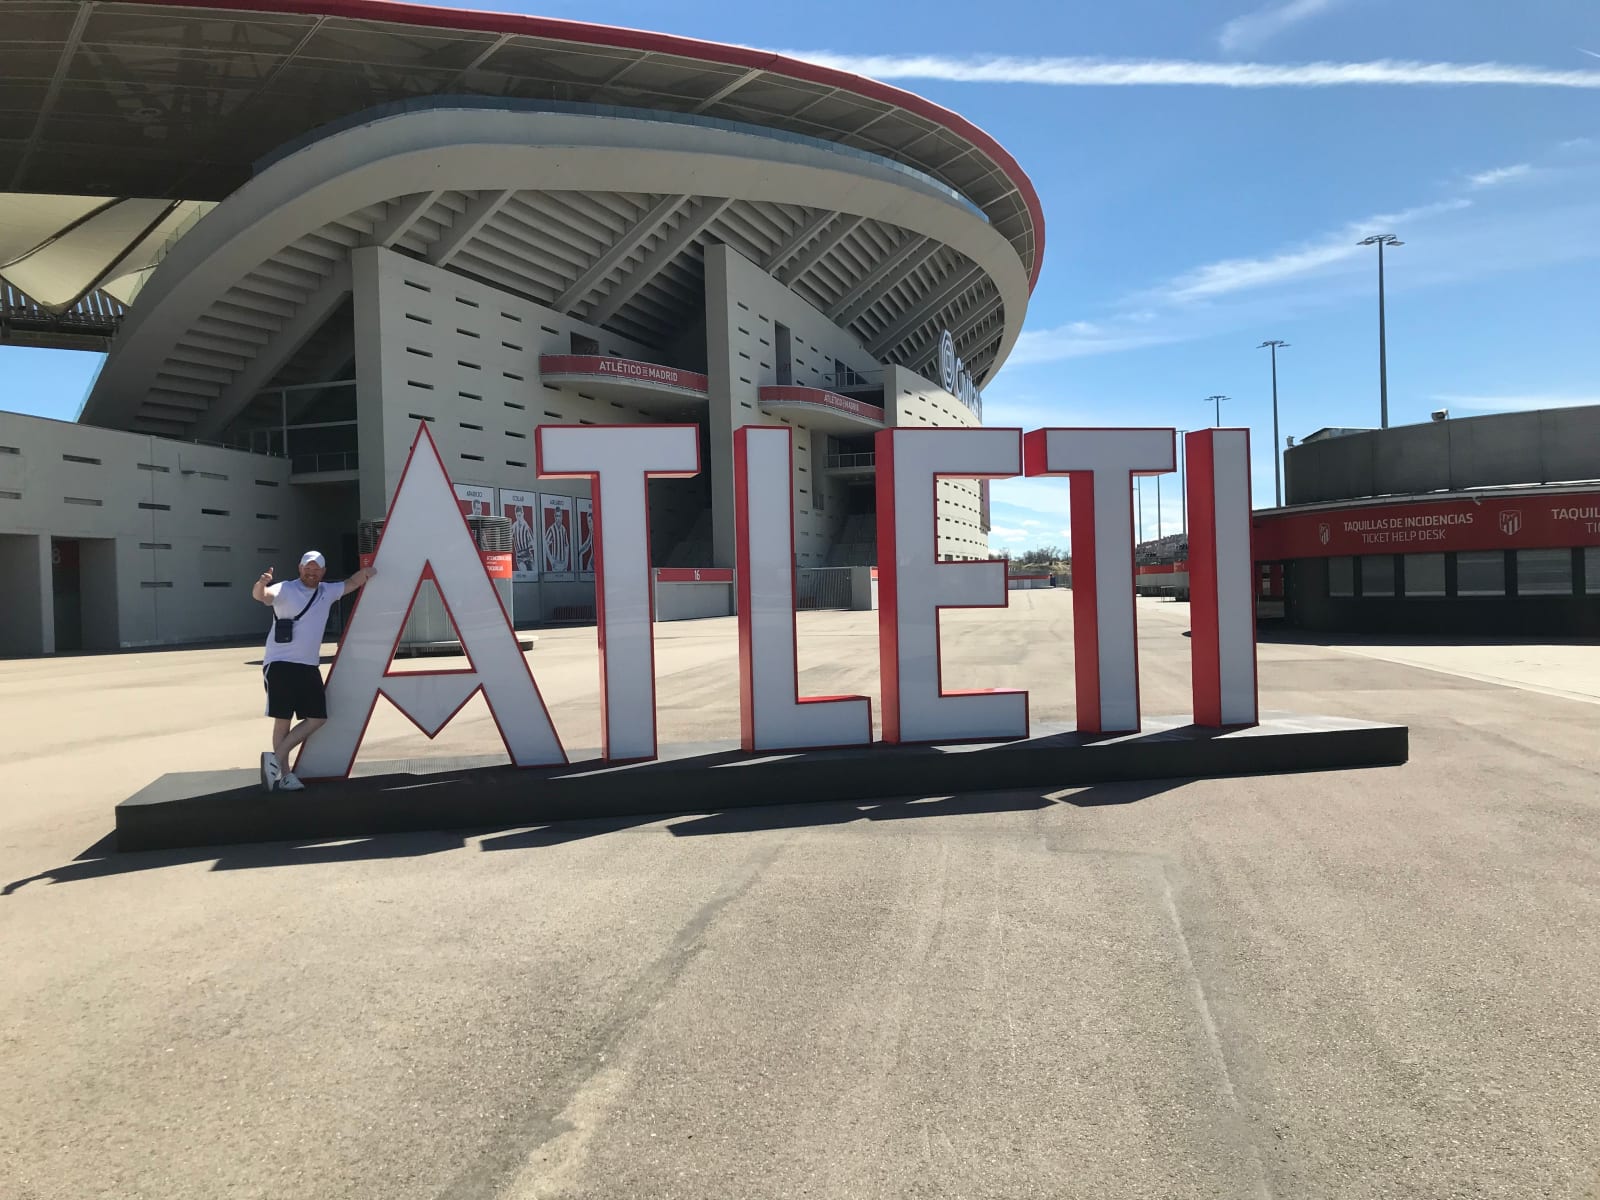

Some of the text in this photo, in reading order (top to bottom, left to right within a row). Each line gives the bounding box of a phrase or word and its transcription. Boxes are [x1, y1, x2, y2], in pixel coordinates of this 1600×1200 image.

[599, 361, 641, 375] ATLÉTICO
[648, 368, 678, 381] MADRID
[1343, 513, 1473, 532] TAQUILLAS DE INCIDENCIAS
[1584, 522, 1600, 533] TI
[1362, 528, 1447, 544] TICKET HELP DESK
[694, 569, 701, 581] 16
[296, 419, 1258, 779] ATLETI
